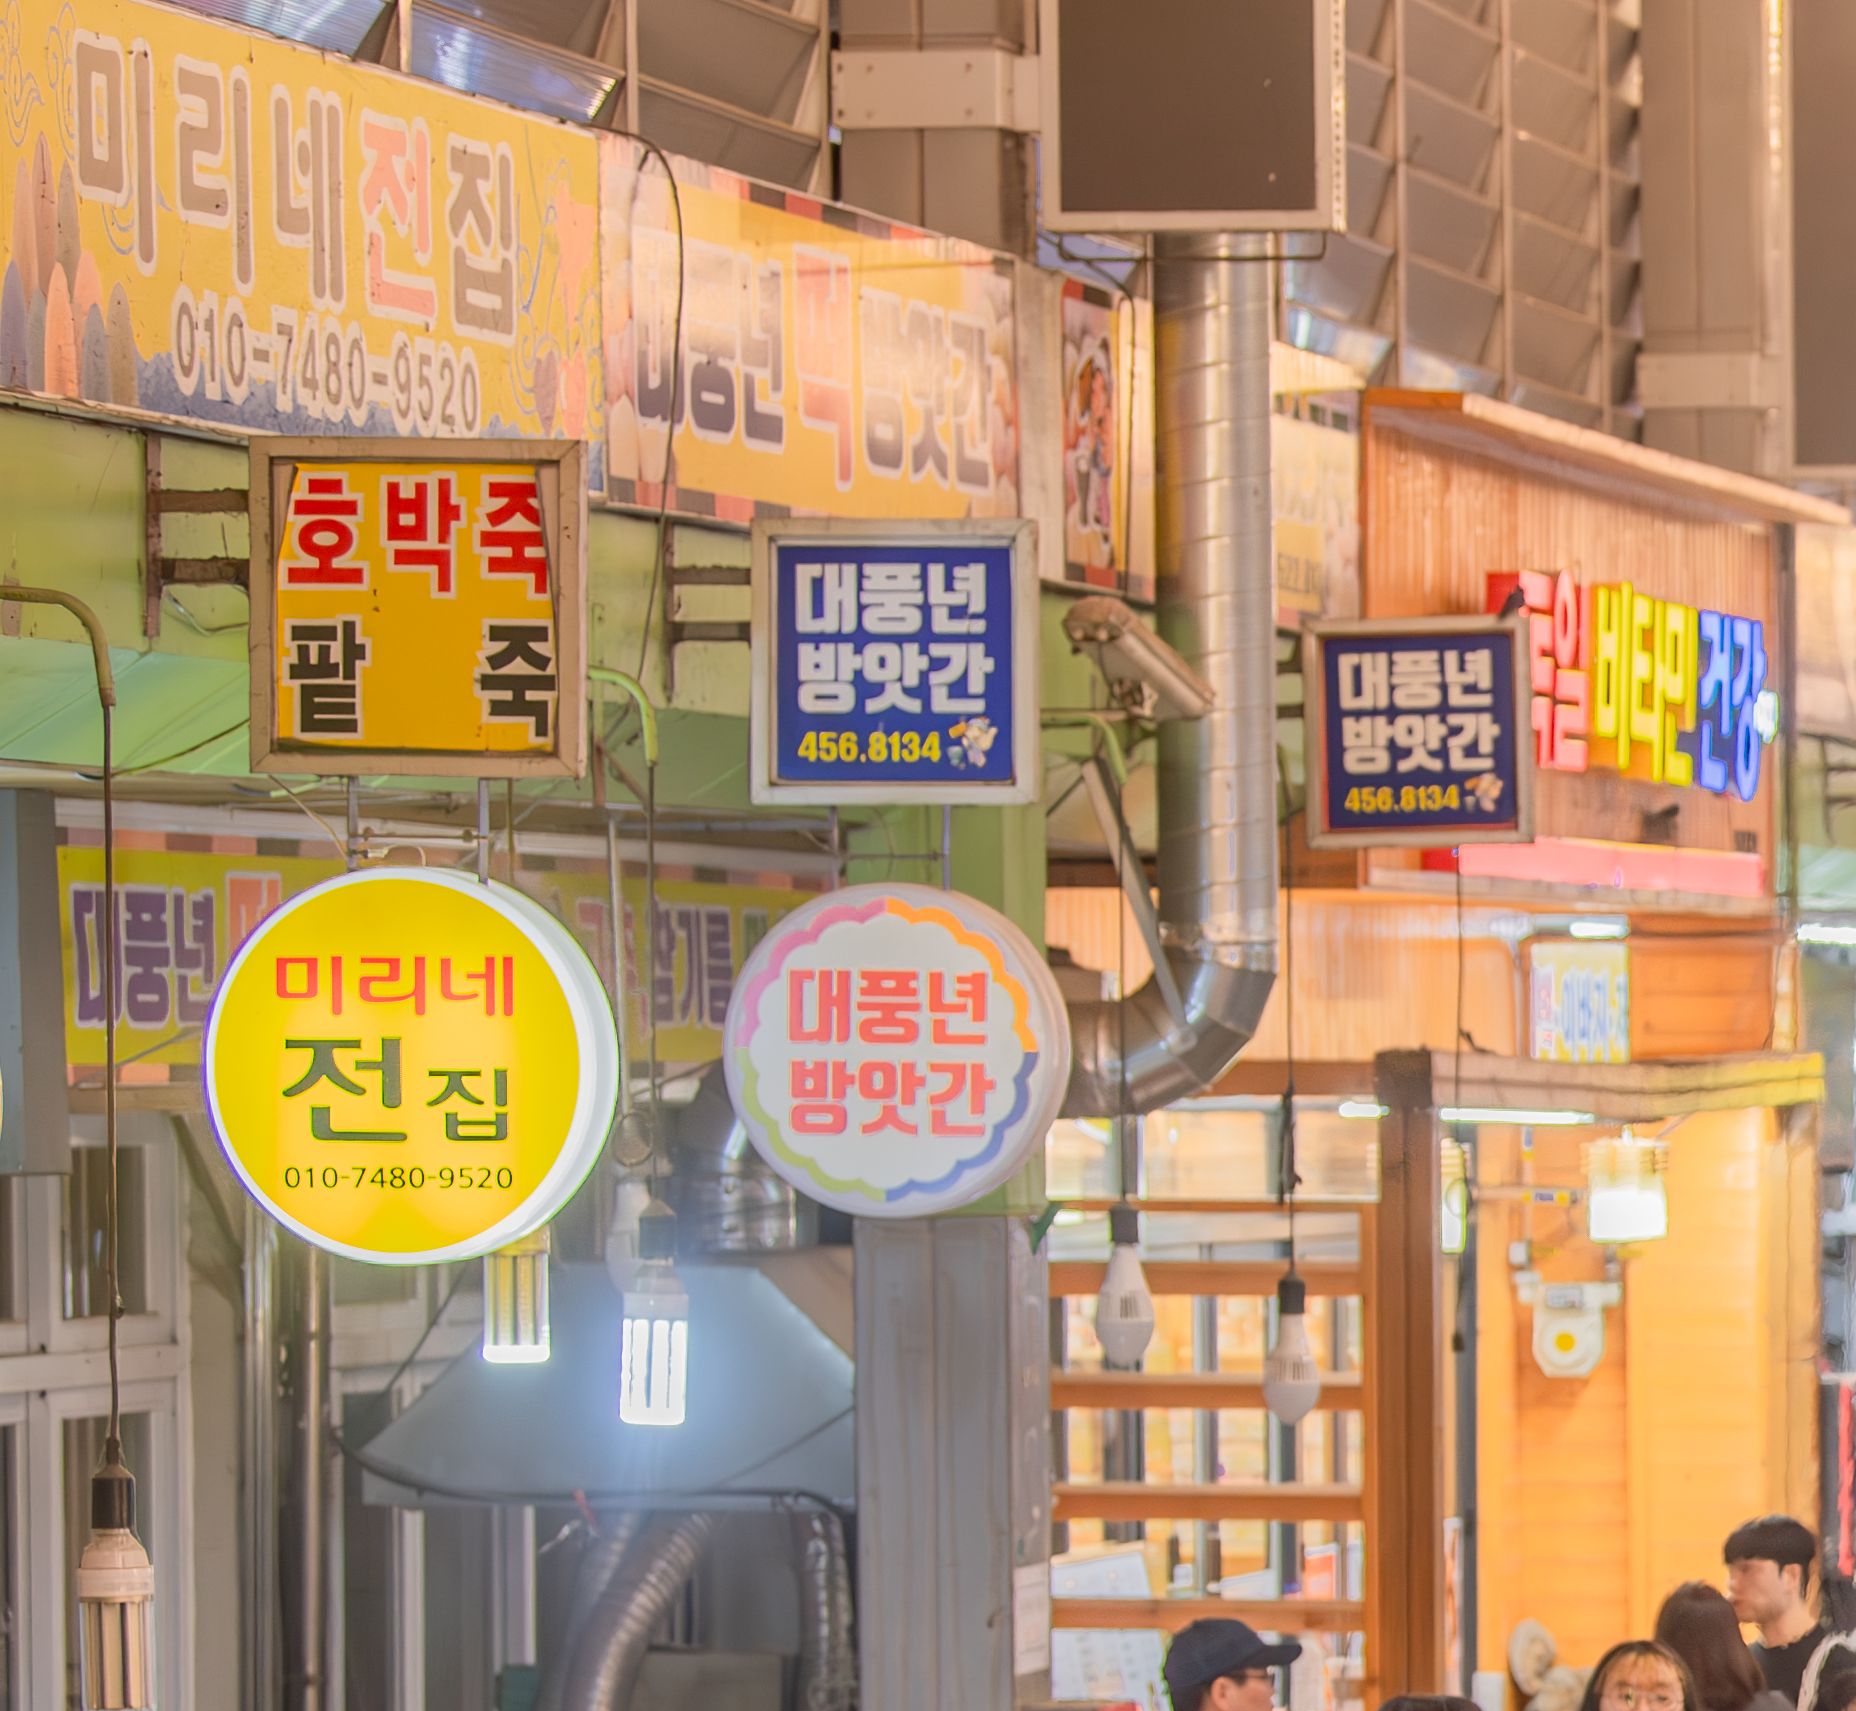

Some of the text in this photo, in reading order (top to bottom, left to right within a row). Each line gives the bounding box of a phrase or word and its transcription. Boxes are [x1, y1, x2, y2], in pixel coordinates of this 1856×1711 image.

[171, 284, 482, 437] 010-7480-9520
[284, 474, 550, 595] 호박죽
[794, 562, 988, 634] 대풍년
[287, 619, 557, 740] 팥 죽
[797, 642, 995, 714] 방앗간
[1337, 648, 1494, 711] 대풍년
[797, 731, 942, 763] 456.8134
[1341, 713, 1501, 776] 방앗간
[1344, 783, 1461, 813] 456.8134
[275, 955, 515, 1016] 미리네
[787, 969, 988, 1045] 대풍년
[281, 1036, 509, 1142] 전집
[788, 1060, 995, 1137] 방앗간
[284, 1167, 513, 1190] 010-7480-9520
